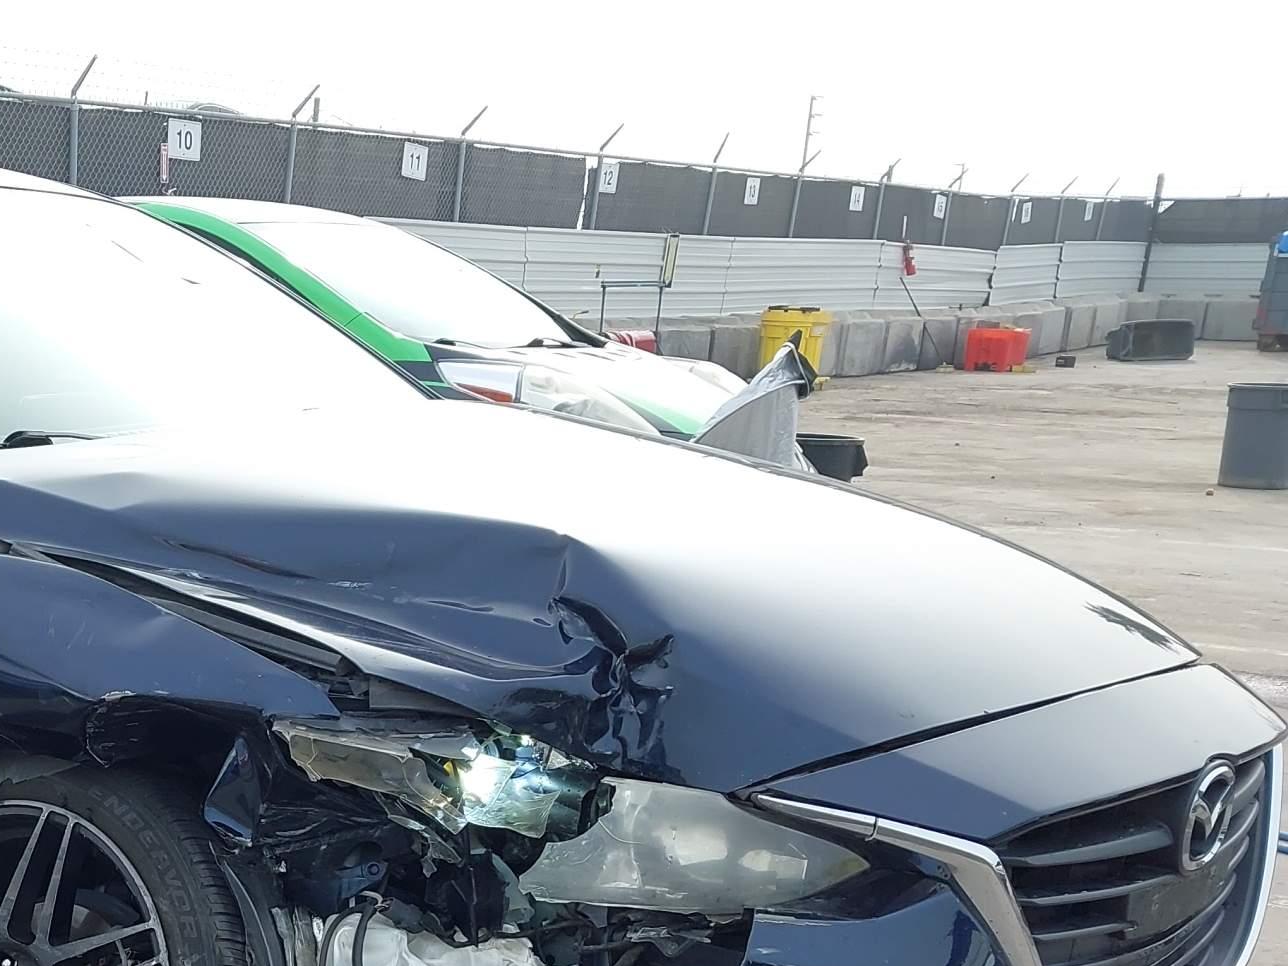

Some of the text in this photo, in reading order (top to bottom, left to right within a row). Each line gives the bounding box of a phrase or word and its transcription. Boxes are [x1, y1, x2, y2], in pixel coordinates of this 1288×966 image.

[176, 129, 193, 150] 10
[410, 152, 421, 171] 11
[604, 170, 614, 185] 12
